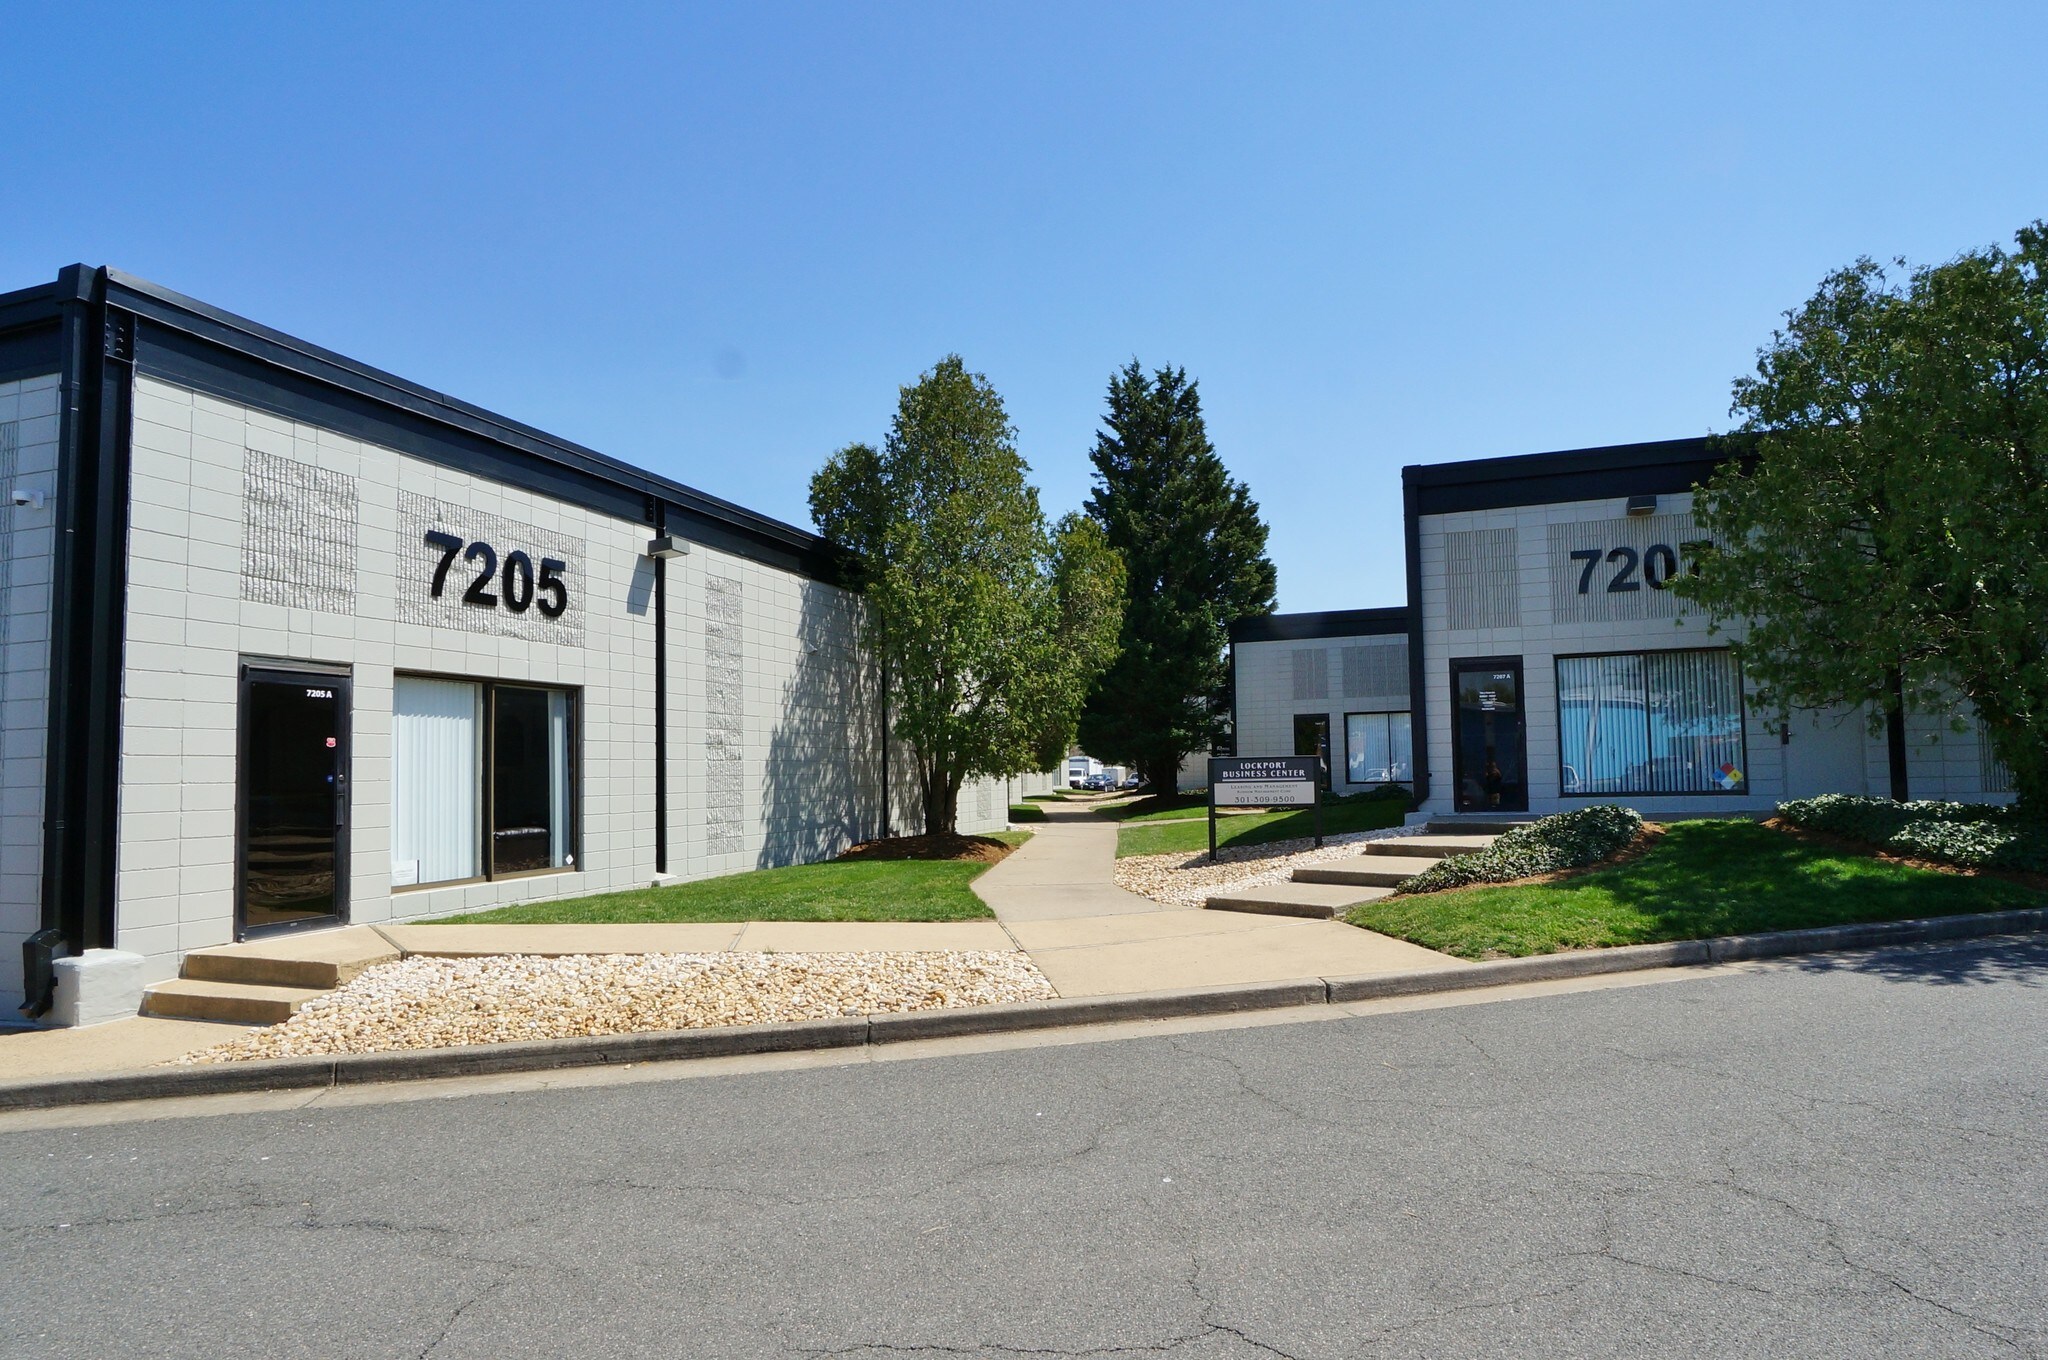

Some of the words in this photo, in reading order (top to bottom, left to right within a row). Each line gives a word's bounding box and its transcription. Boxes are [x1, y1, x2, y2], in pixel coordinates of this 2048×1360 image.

[425, 529, 568, 618] 7205
[306, 689, 326, 698] 7205
[326, 690, 333, 699] A
[1222, 770, 1267, 778] BUSINESS
[1270, 769, 1305, 777] CENTER
[1235, 795, 1295, 803] 301-309-9500
